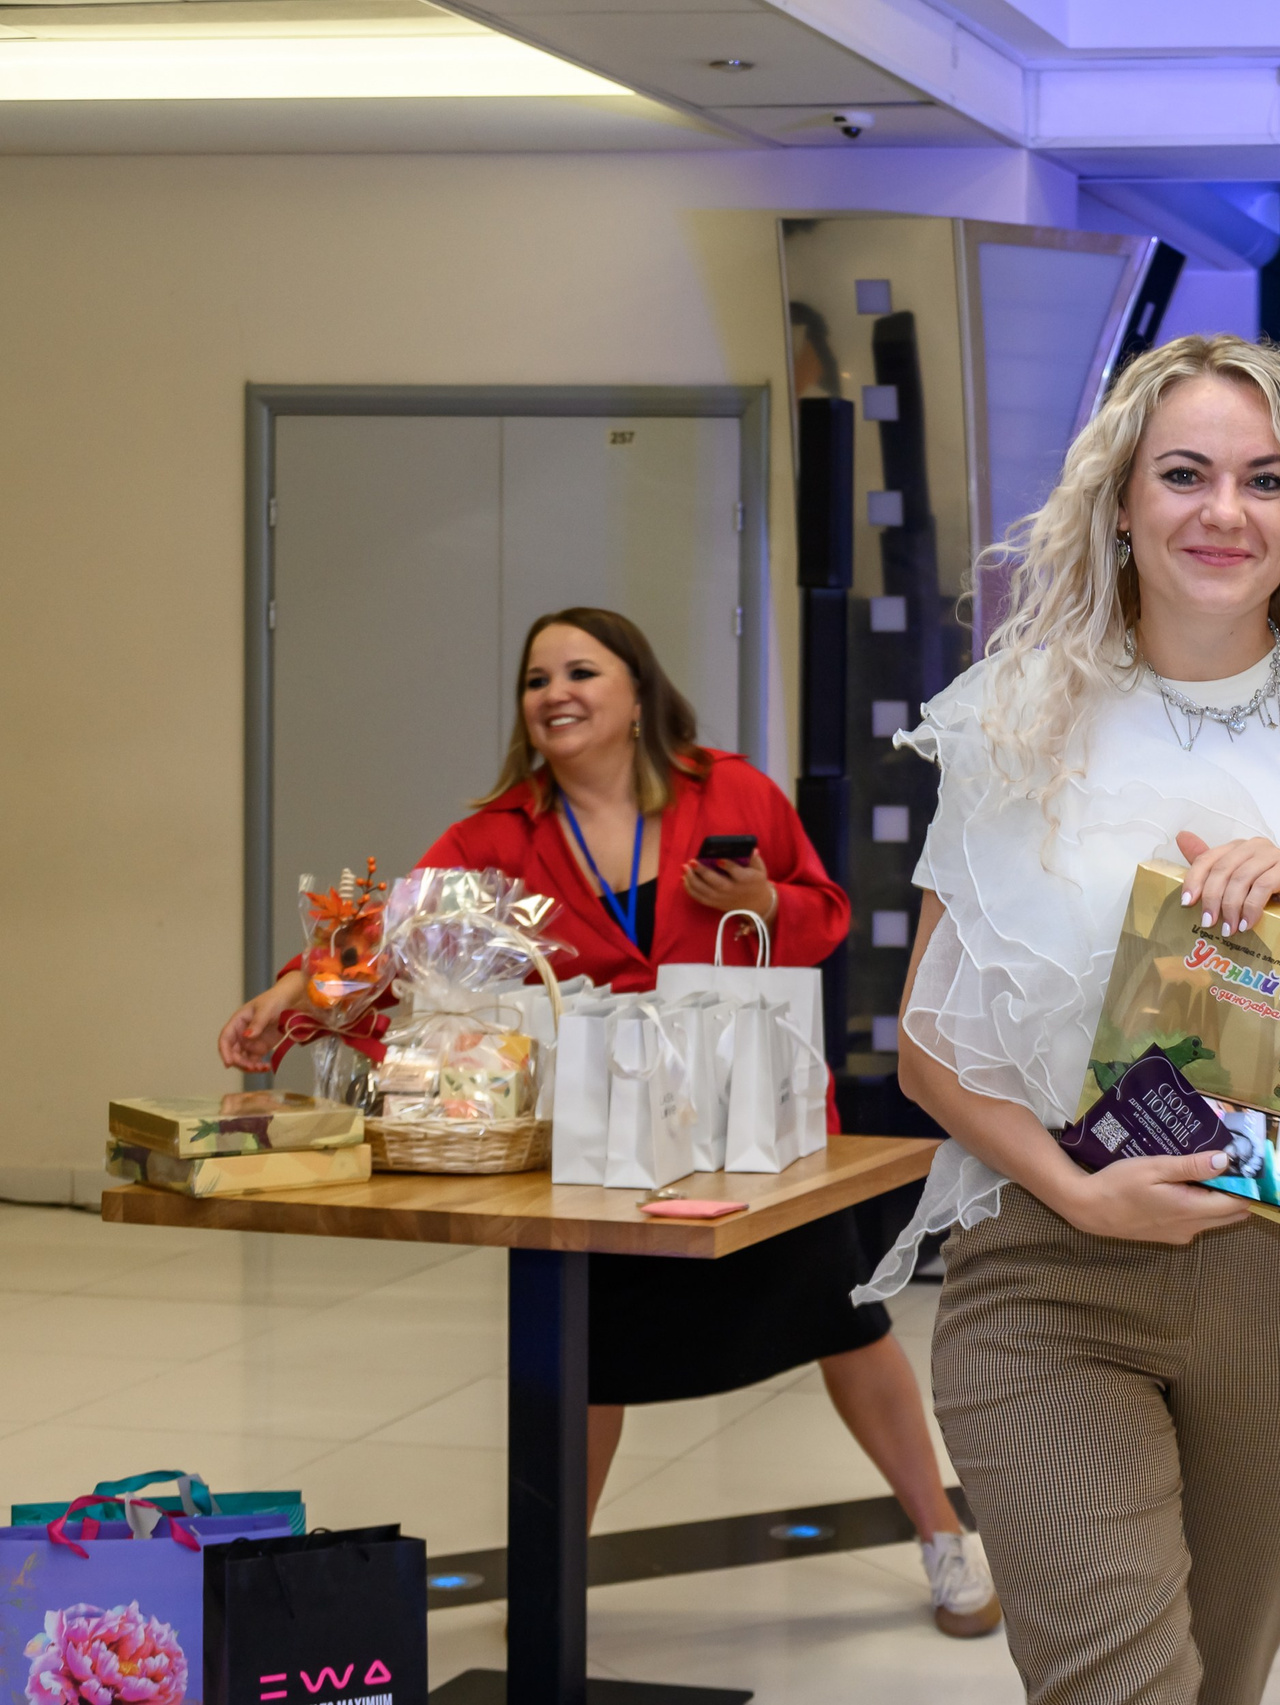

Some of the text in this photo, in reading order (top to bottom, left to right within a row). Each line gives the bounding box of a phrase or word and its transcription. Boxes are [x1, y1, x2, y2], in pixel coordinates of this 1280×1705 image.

[610, 430, 635, 445] 257
[1128, 1097, 1182, 1156] ДЛЯ ТВОЕГО БИЗНЕС
[1157, 1083, 1202, 1134] СКОРАЯ
[1132, 1111, 1174, 1156] И ОТНОШЕНИЙ
